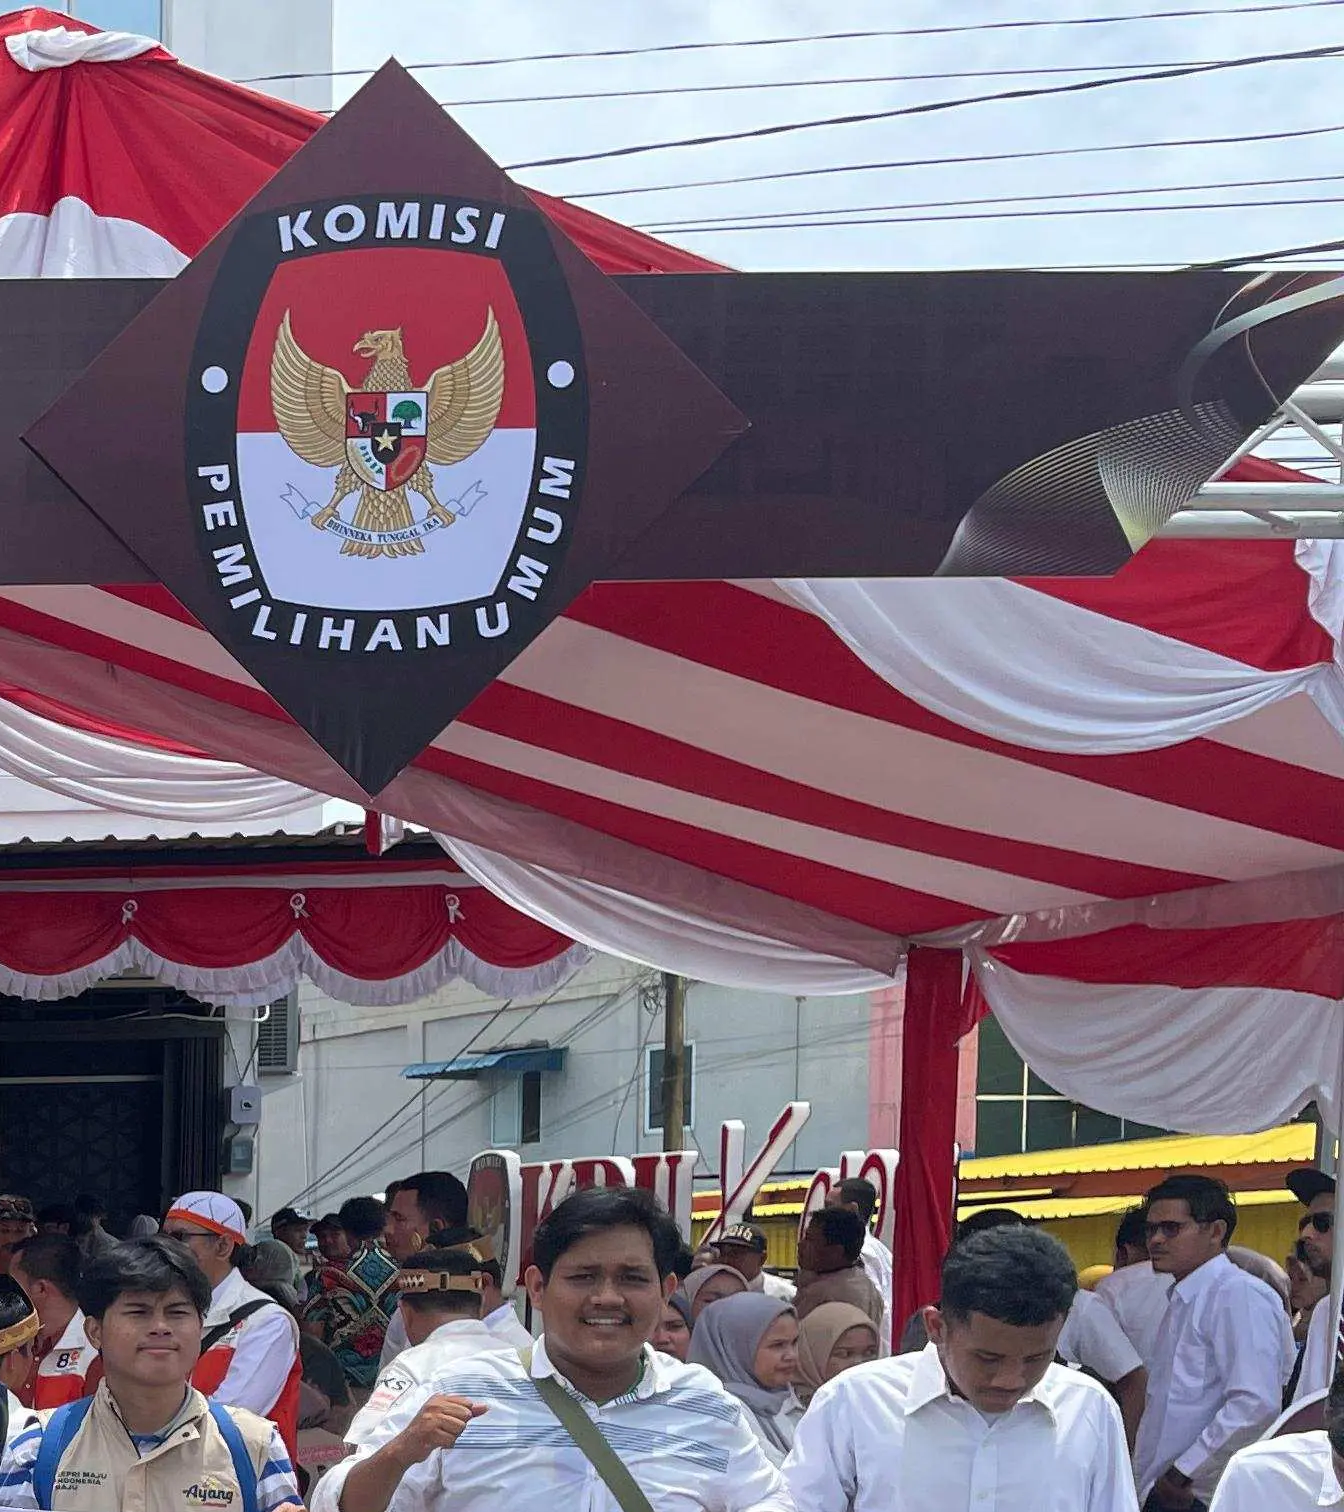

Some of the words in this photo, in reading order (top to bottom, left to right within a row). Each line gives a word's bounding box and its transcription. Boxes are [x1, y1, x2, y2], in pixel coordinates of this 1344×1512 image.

[277, 202, 508, 253] KOMISI
[326, 519, 373, 543] BHINNEKA
[377, 527, 421, 544] TUNGGAL
[422, 517, 441, 532] IKA
[198, 464, 451, 652] PEMILIHAN
[475, 455, 576, 640] UMUM
[56, 1352, 70, 1368] 8
[183, 1484, 234, 1505] Ayang
